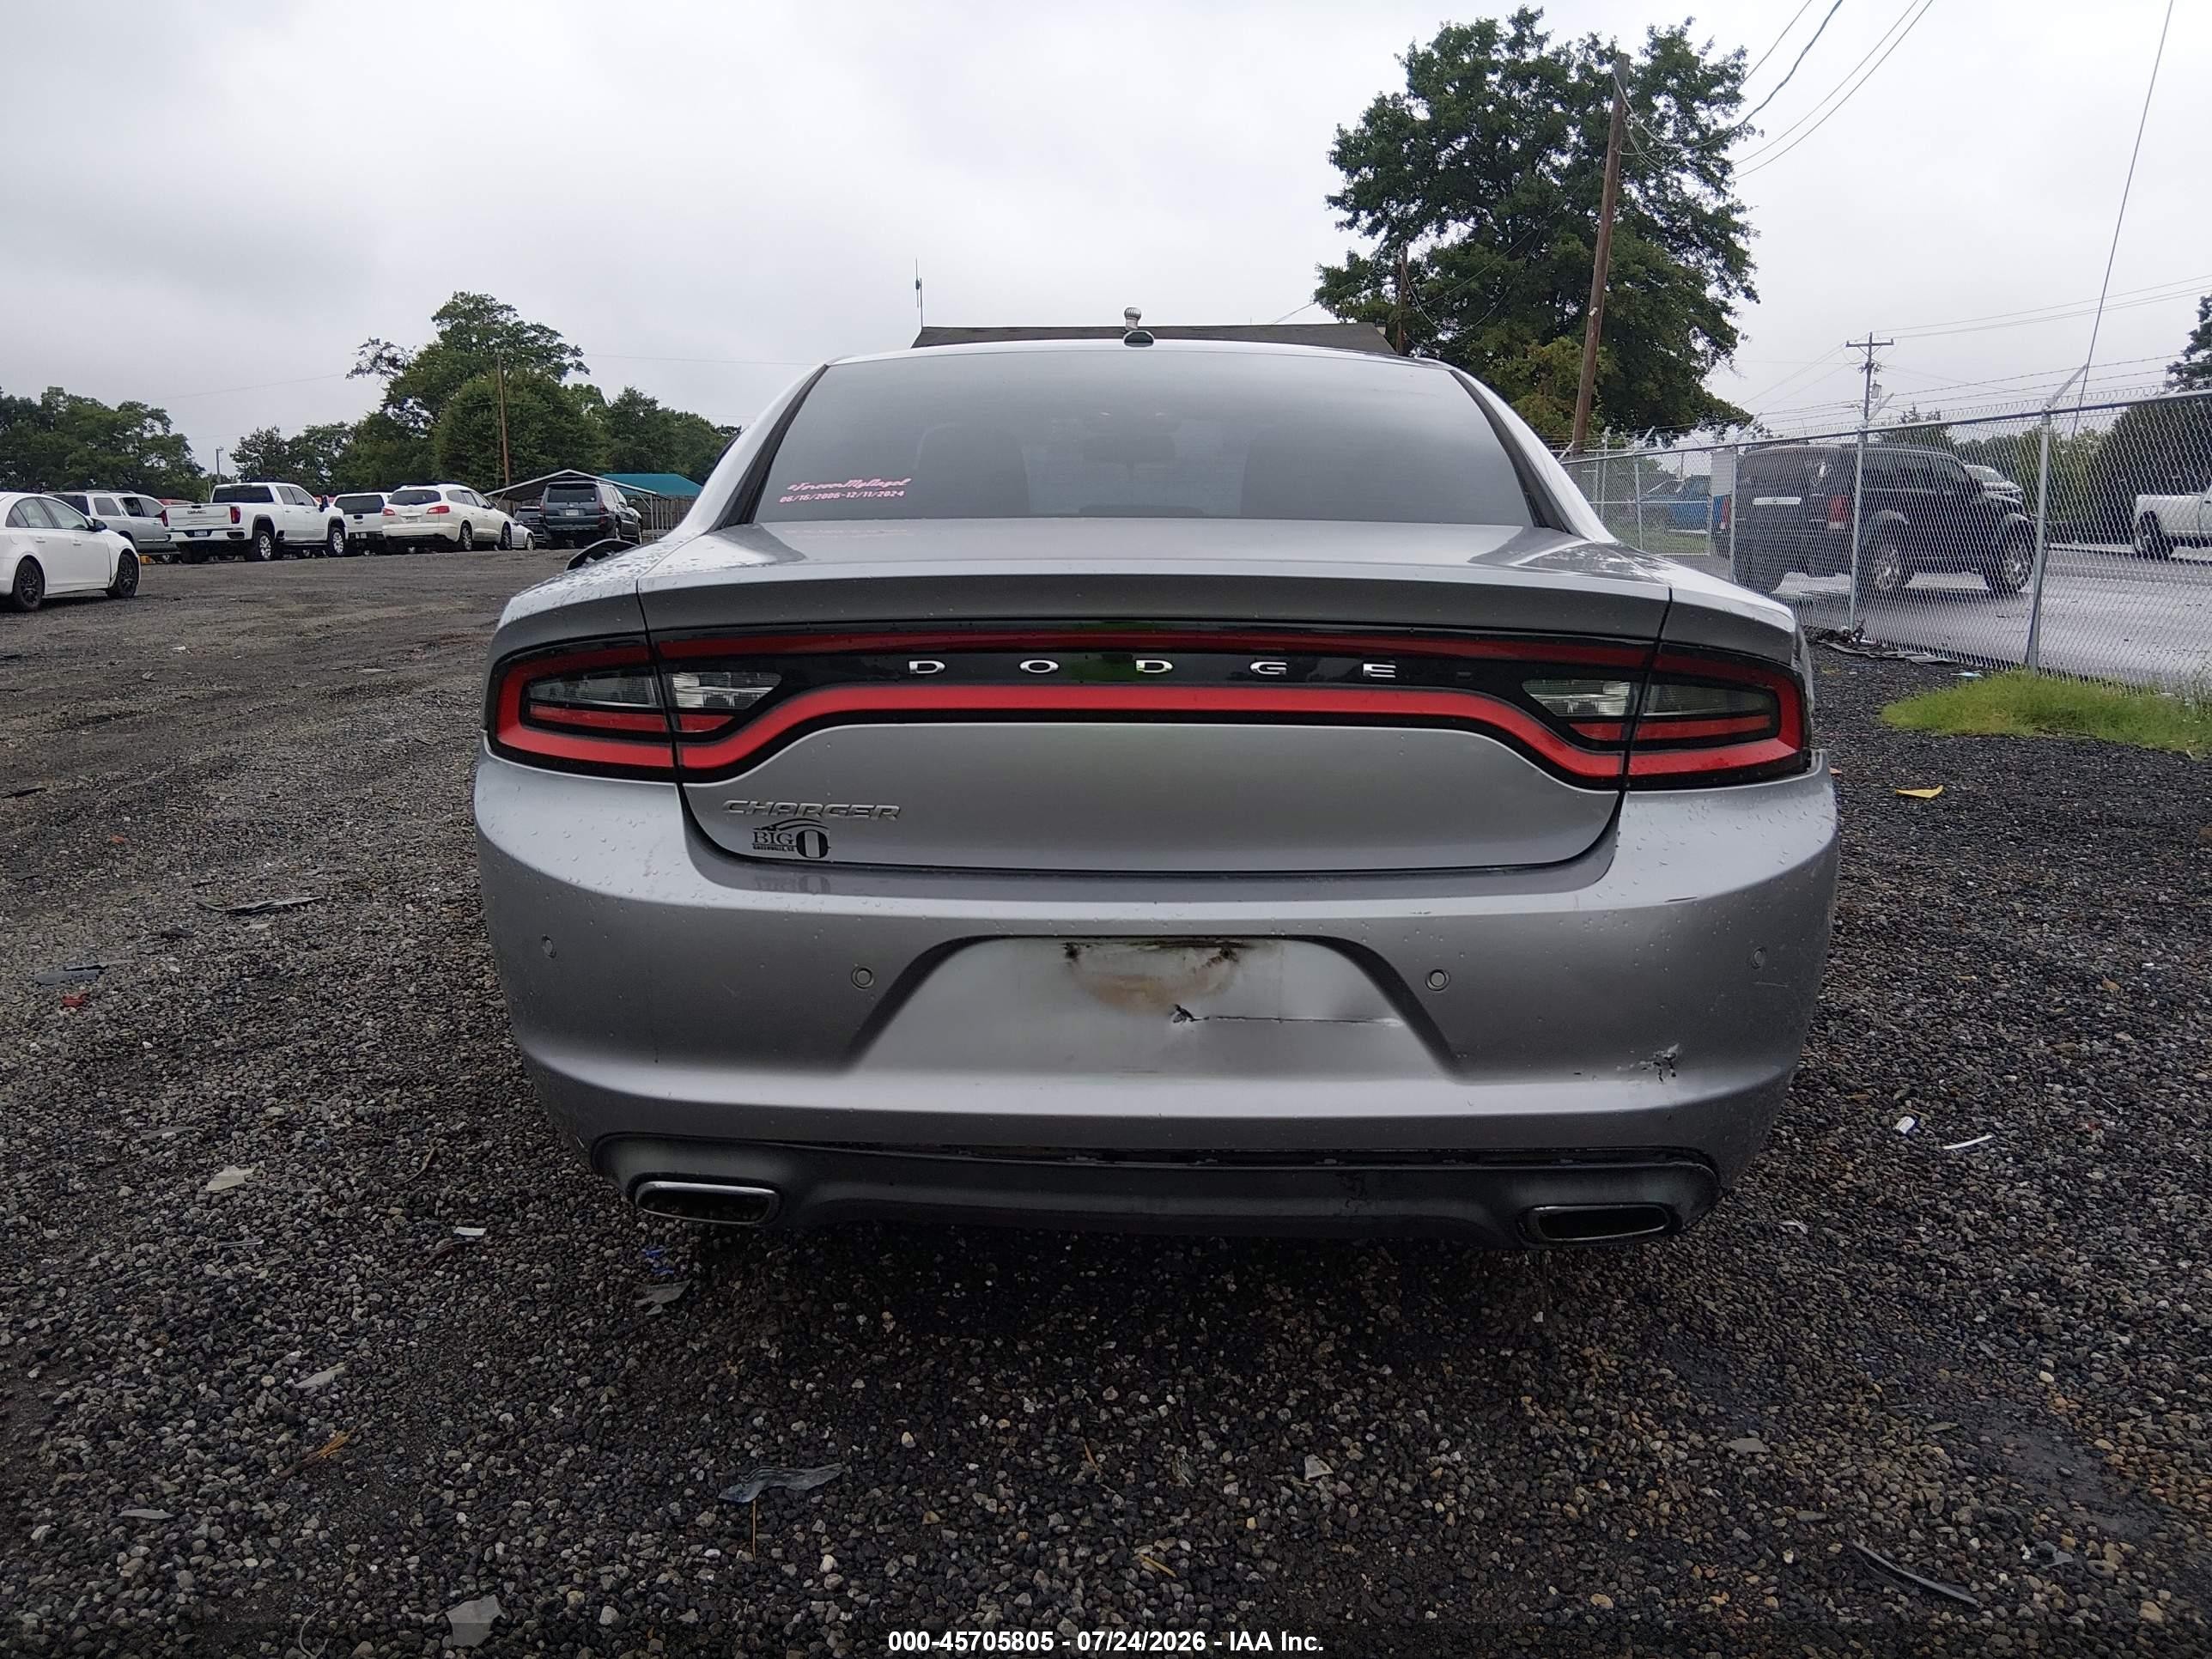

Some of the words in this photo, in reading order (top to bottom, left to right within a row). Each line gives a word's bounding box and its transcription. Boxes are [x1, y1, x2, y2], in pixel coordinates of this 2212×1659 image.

[908, 659, 1396, 678] DODGE
[722, 799, 900, 821] CHARGER
[753, 830, 794, 845] BIG
[796, 830, 829, 859] O
